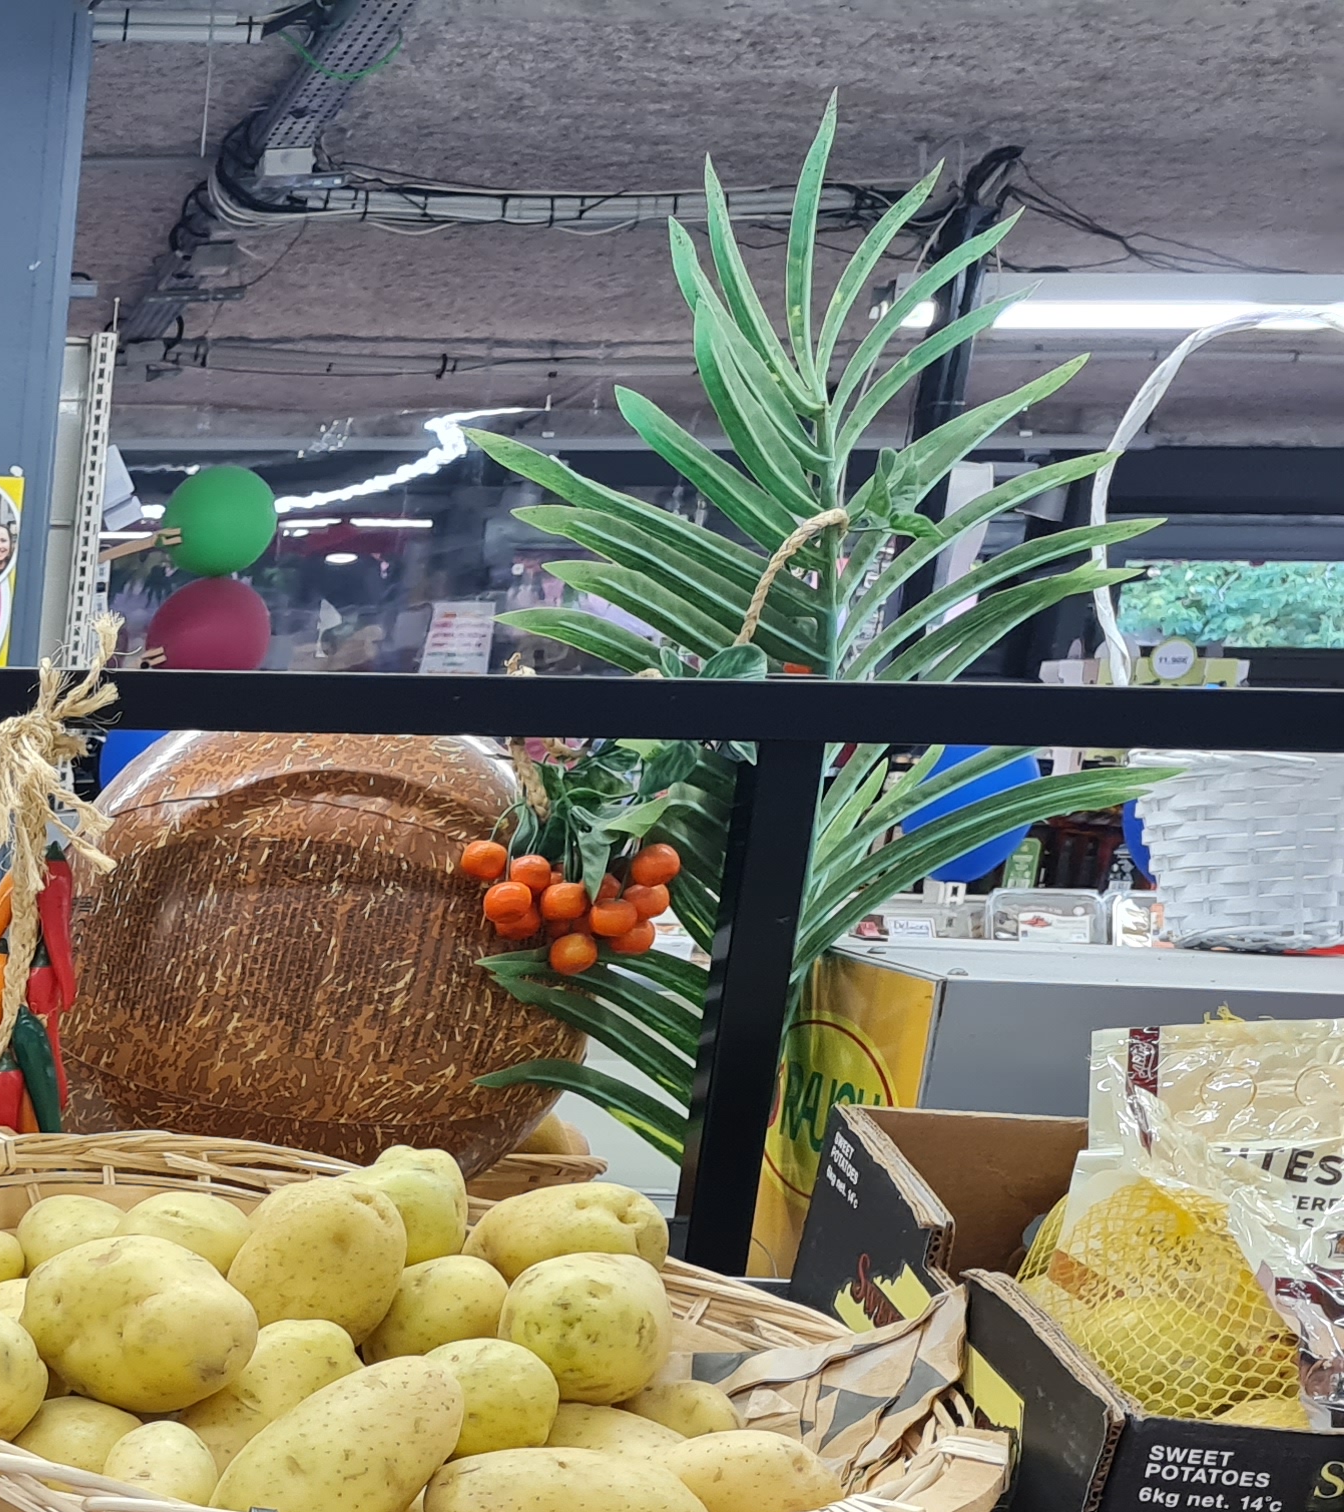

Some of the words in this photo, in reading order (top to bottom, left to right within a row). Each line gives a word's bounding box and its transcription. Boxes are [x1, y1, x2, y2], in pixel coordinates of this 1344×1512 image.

[833, 1131, 855, 1161] SWEET
[830, 1146, 860, 1186] POTATOES
[1149, 1445, 1234, 1467] SWEET
[1144, 1463, 1271, 1488] POTATOES
[1138, 1487, 1180, 1508] 6kg
[1186, 1494, 1230, 1509] net.
